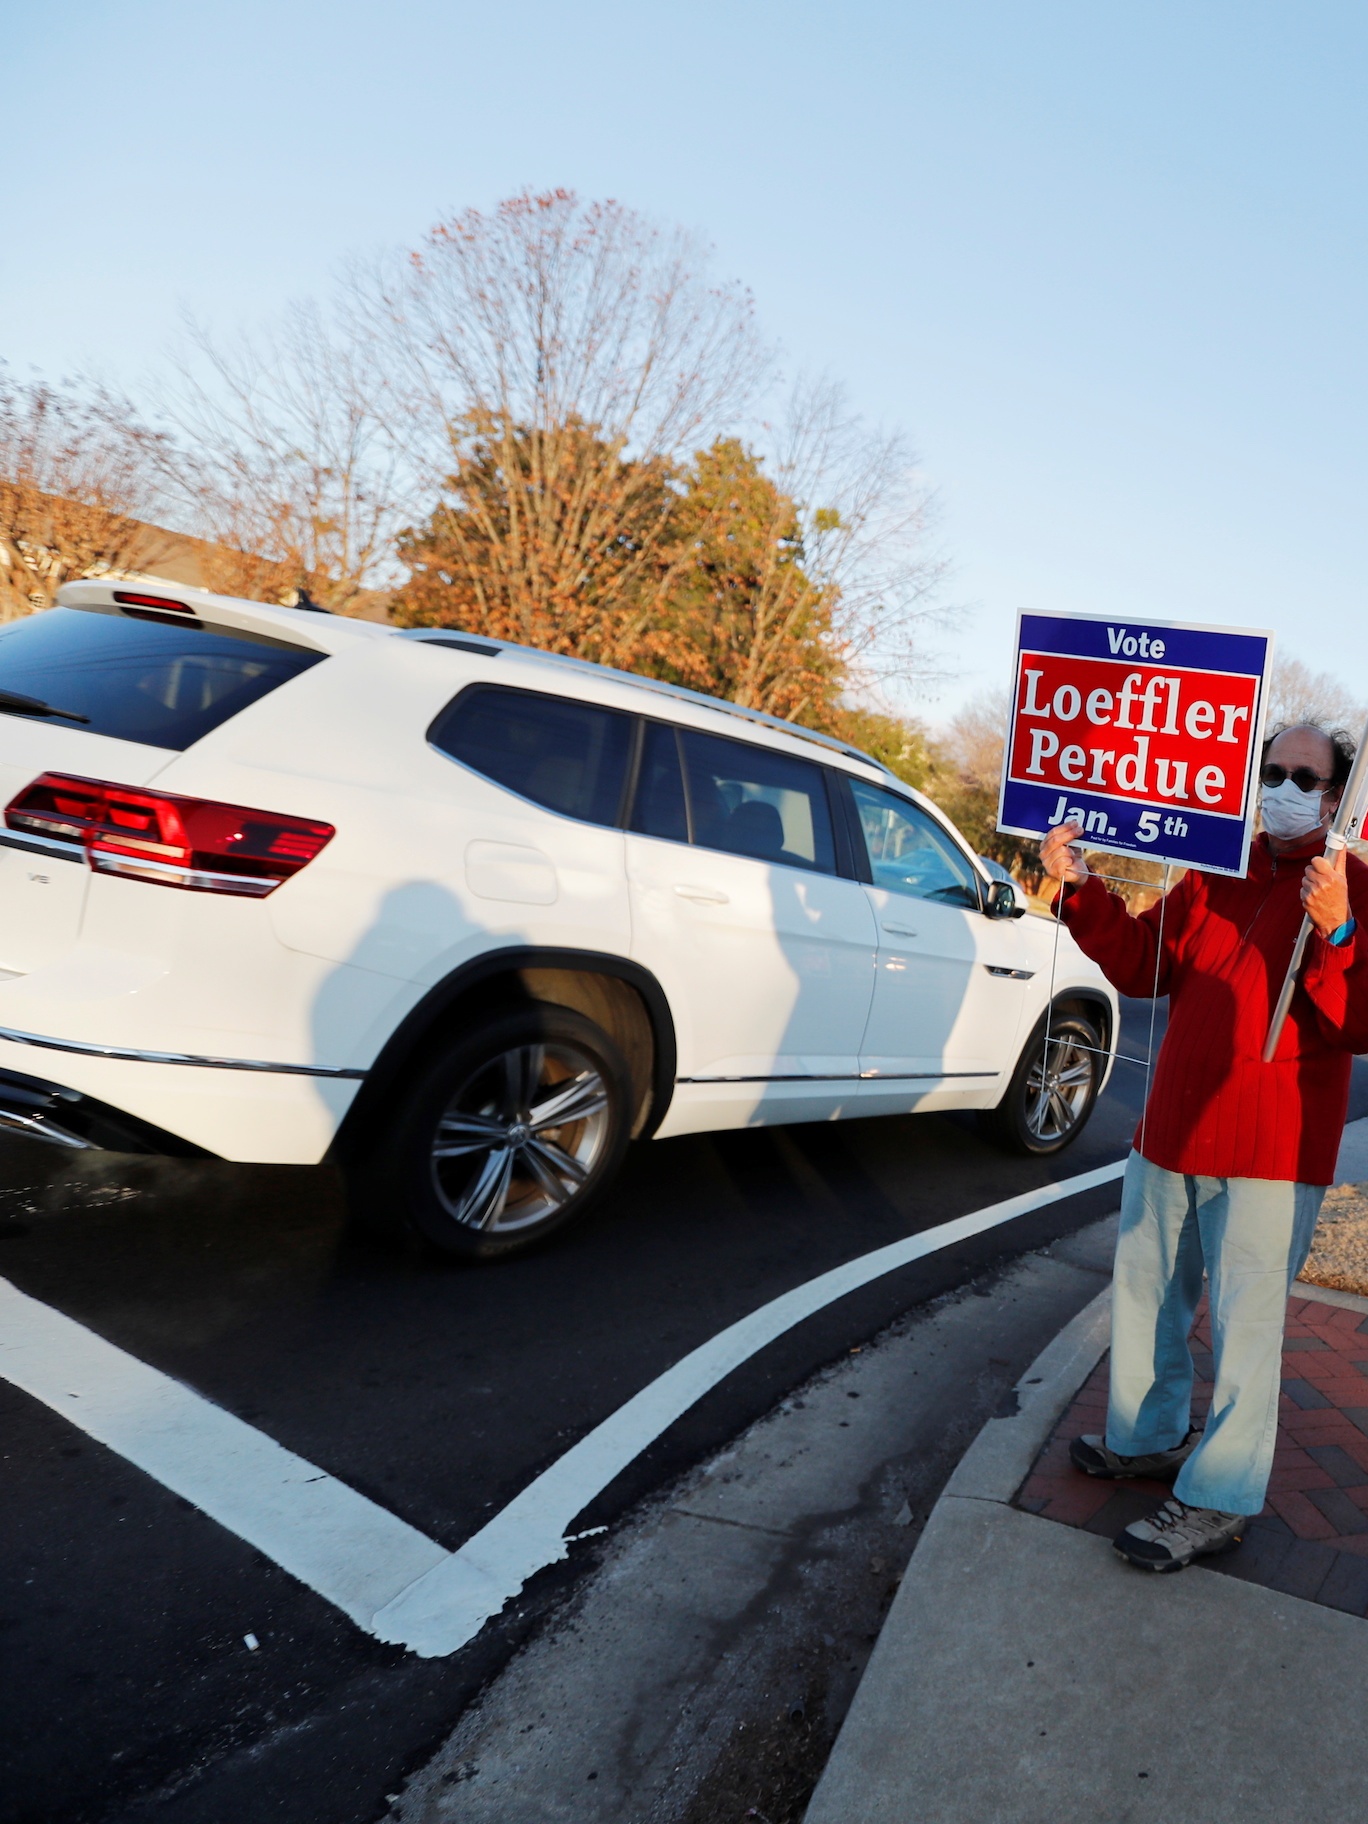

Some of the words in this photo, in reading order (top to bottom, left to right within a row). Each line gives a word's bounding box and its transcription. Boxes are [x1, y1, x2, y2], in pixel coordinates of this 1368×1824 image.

[1107, 627, 1166, 660] Vote
[1020, 669, 1249, 744] Loeffler
[1025, 728, 1226, 804] Perdue
[1048, 796, 1118, 836] Jan.
[1134, 810, 1189, 843] 5th
